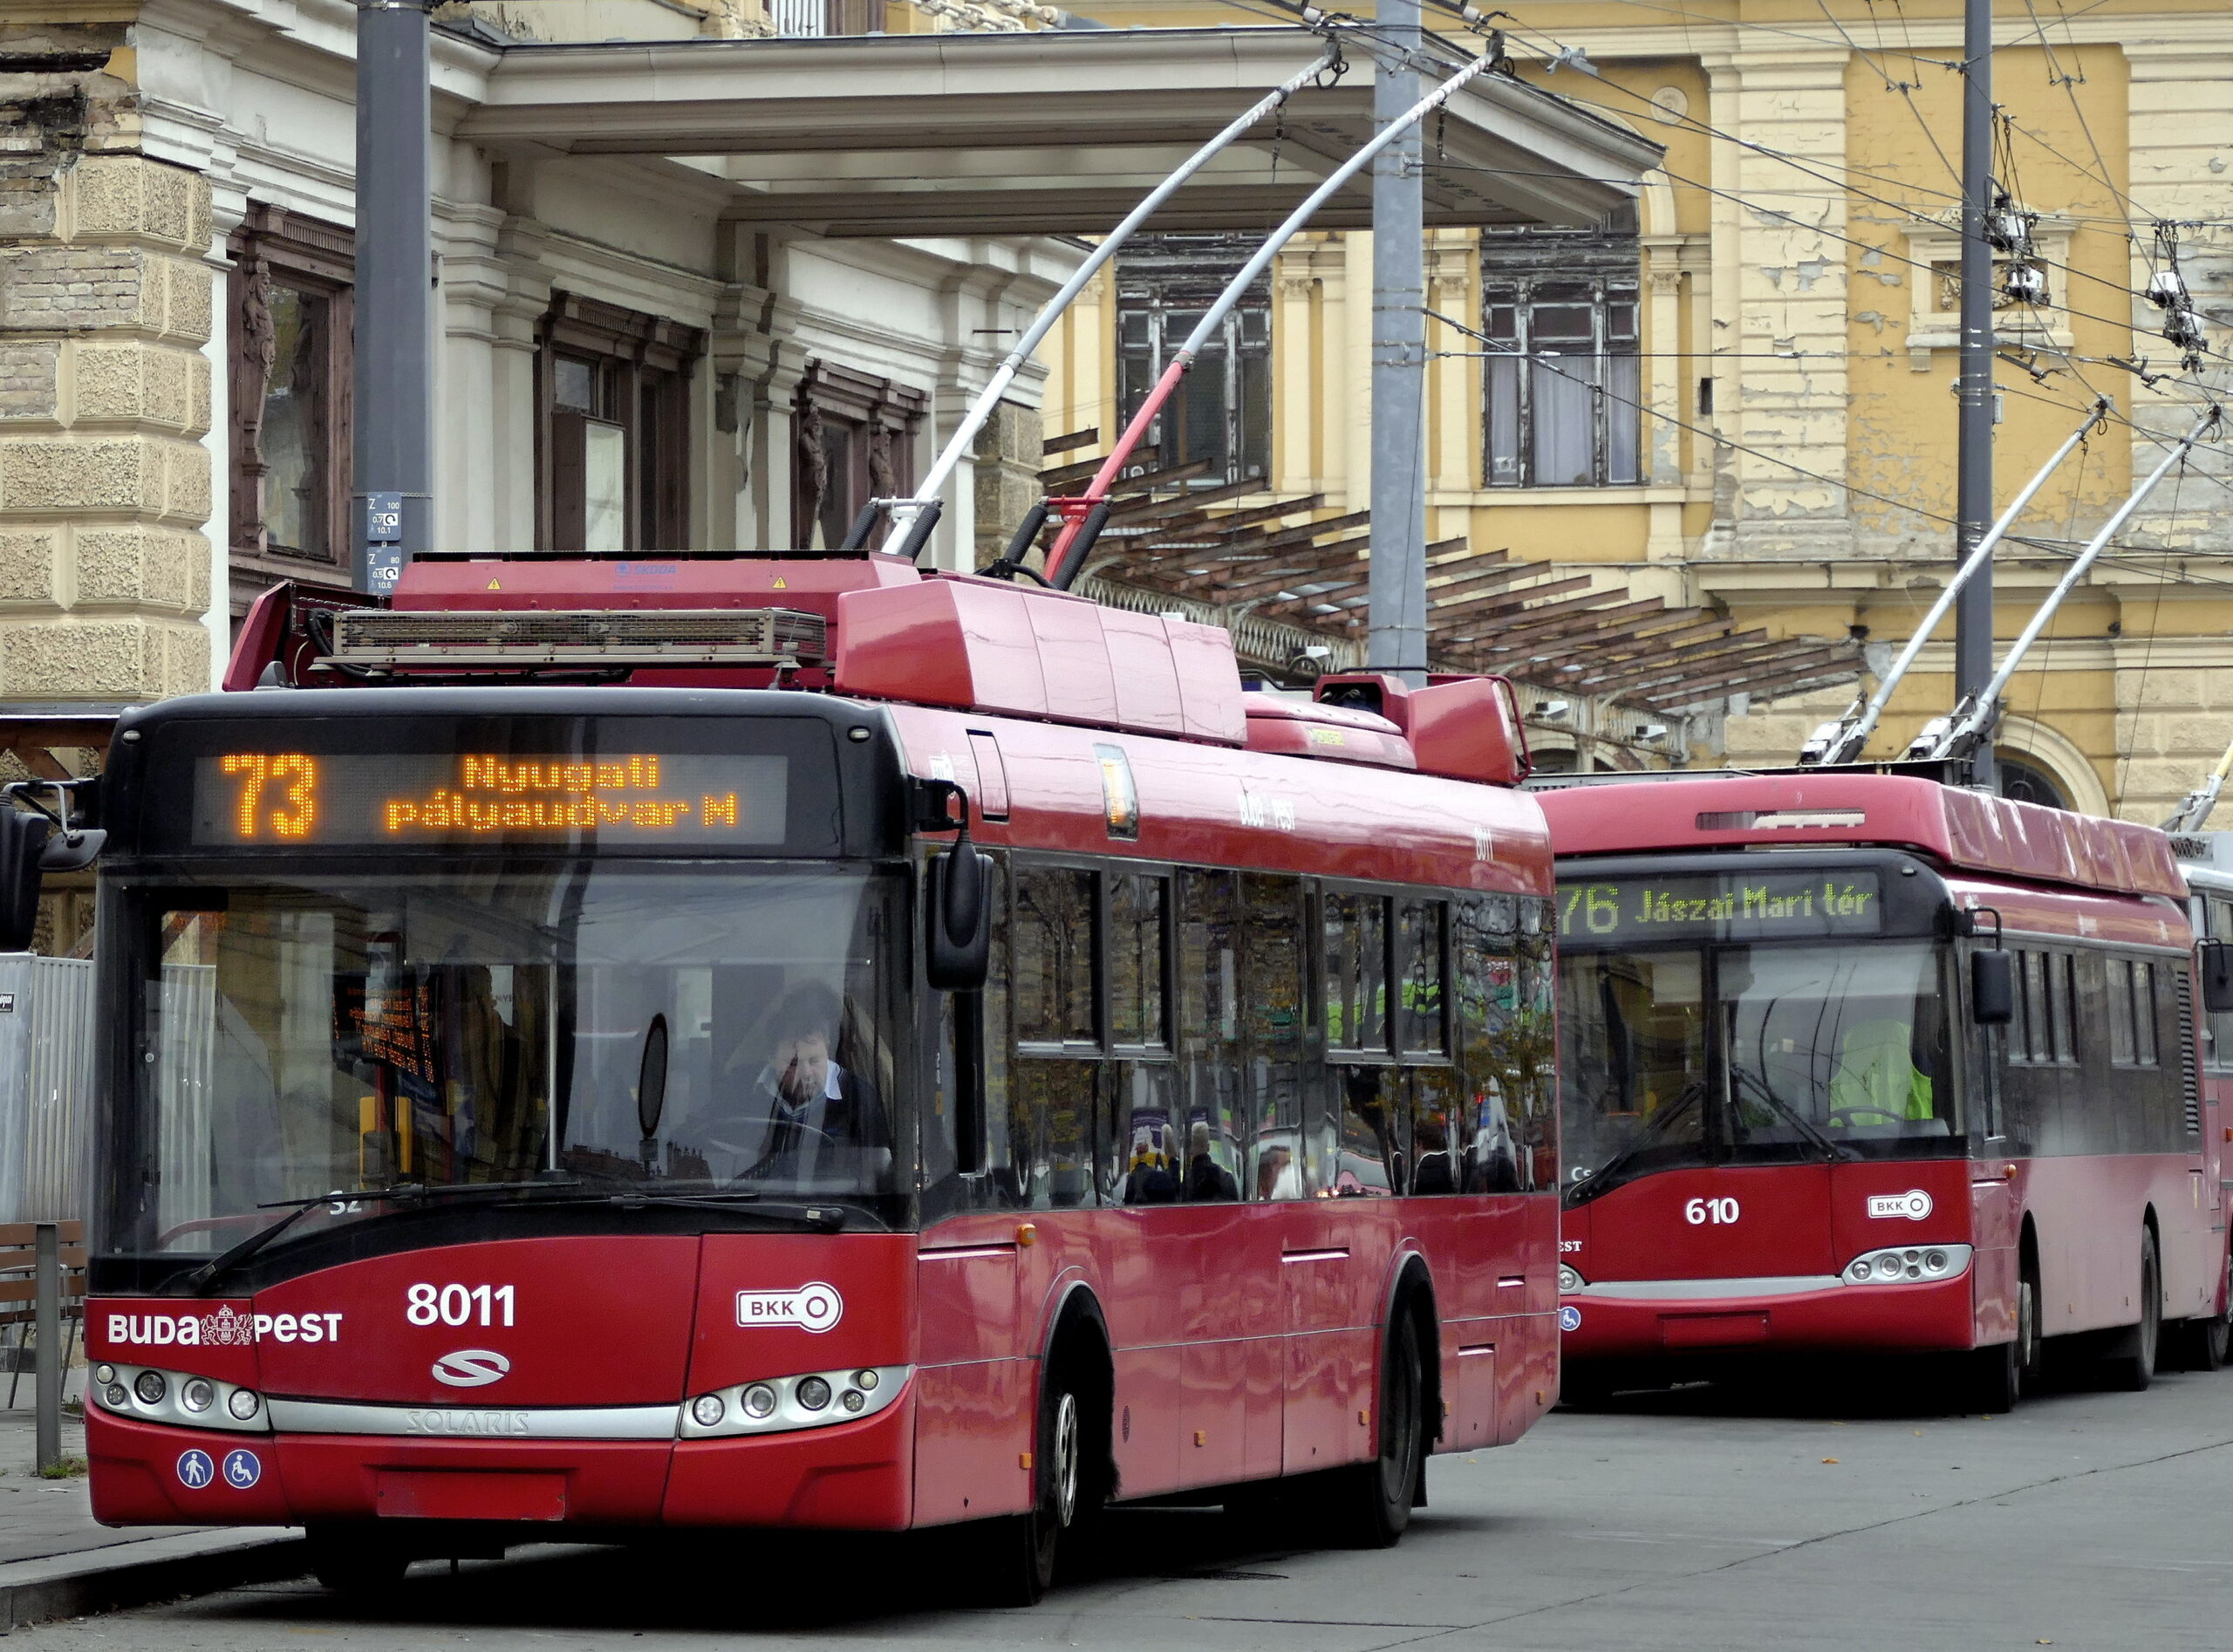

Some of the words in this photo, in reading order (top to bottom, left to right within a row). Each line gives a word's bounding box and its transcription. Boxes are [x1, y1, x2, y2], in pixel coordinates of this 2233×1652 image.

[368, 498, 376, 509] Z
[368, 553, 376, 565] Z
[464, 756, 658, 793] Nyugati
[222, 754, 314, 836] 73
[387, 789, 691, 831] pályaudvar
[702, 792, 735, 827] M
[1555, 883, 1620, 935] 76
[1635, 890, 1734, 923] Jászai
[1744, 885, 1813, 918] Mari
[1822, 882, 1874, 916] tér
[1685, 1197, 1740, 1225] 610
[1877, 1201, 1903, 1212] BKK
[406, 1283, 515, 1327] 8011
[751, 1300, 795, 1316] BKK
[406, 1410, 529, 1435] SOLARIS
